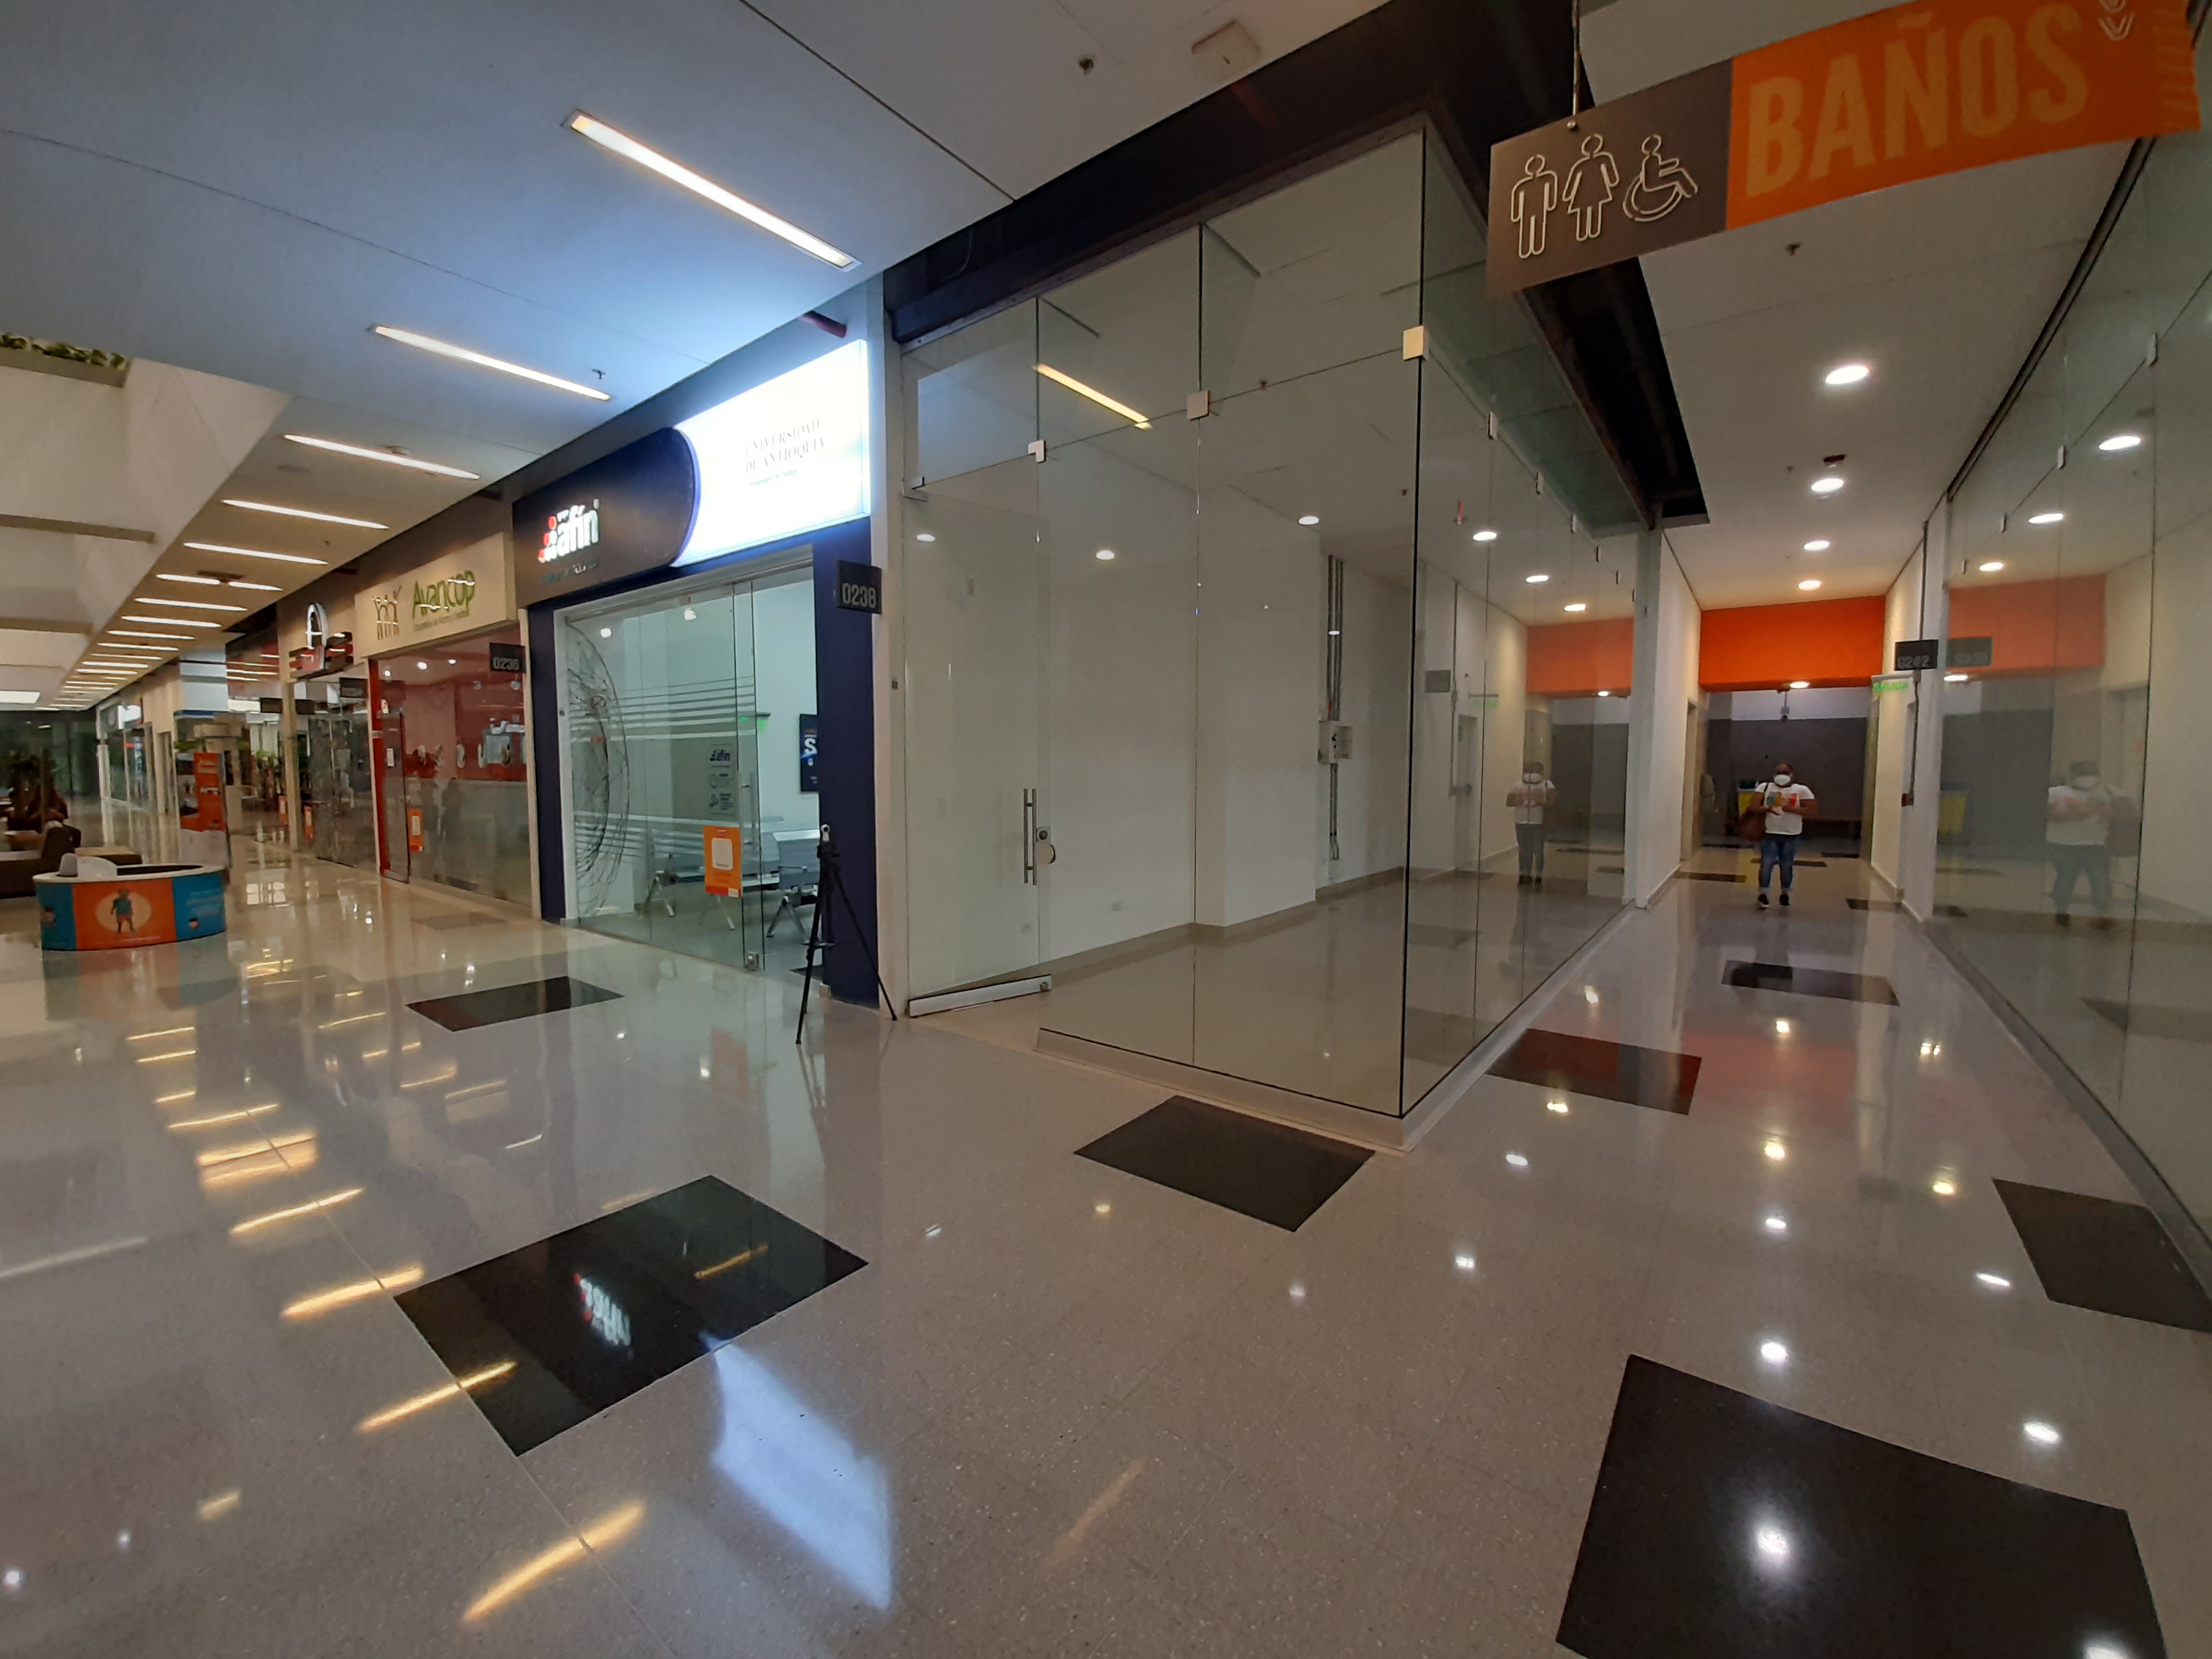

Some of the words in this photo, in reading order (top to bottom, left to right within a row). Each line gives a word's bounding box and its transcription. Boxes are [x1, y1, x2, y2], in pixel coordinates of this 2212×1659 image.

[1746, 4, 2089, 198] BAÑOS
[745, 418, 820, 456] UNIVERSIDAD
[760, 436, 825, 469] ANTIOQUIA
[411, 570, 476, 619] Avancop
[842, 583, 876, 609] 0238
[493, 657, 520, 671] 0236
[1898, 655, 1930, 670] 0242
